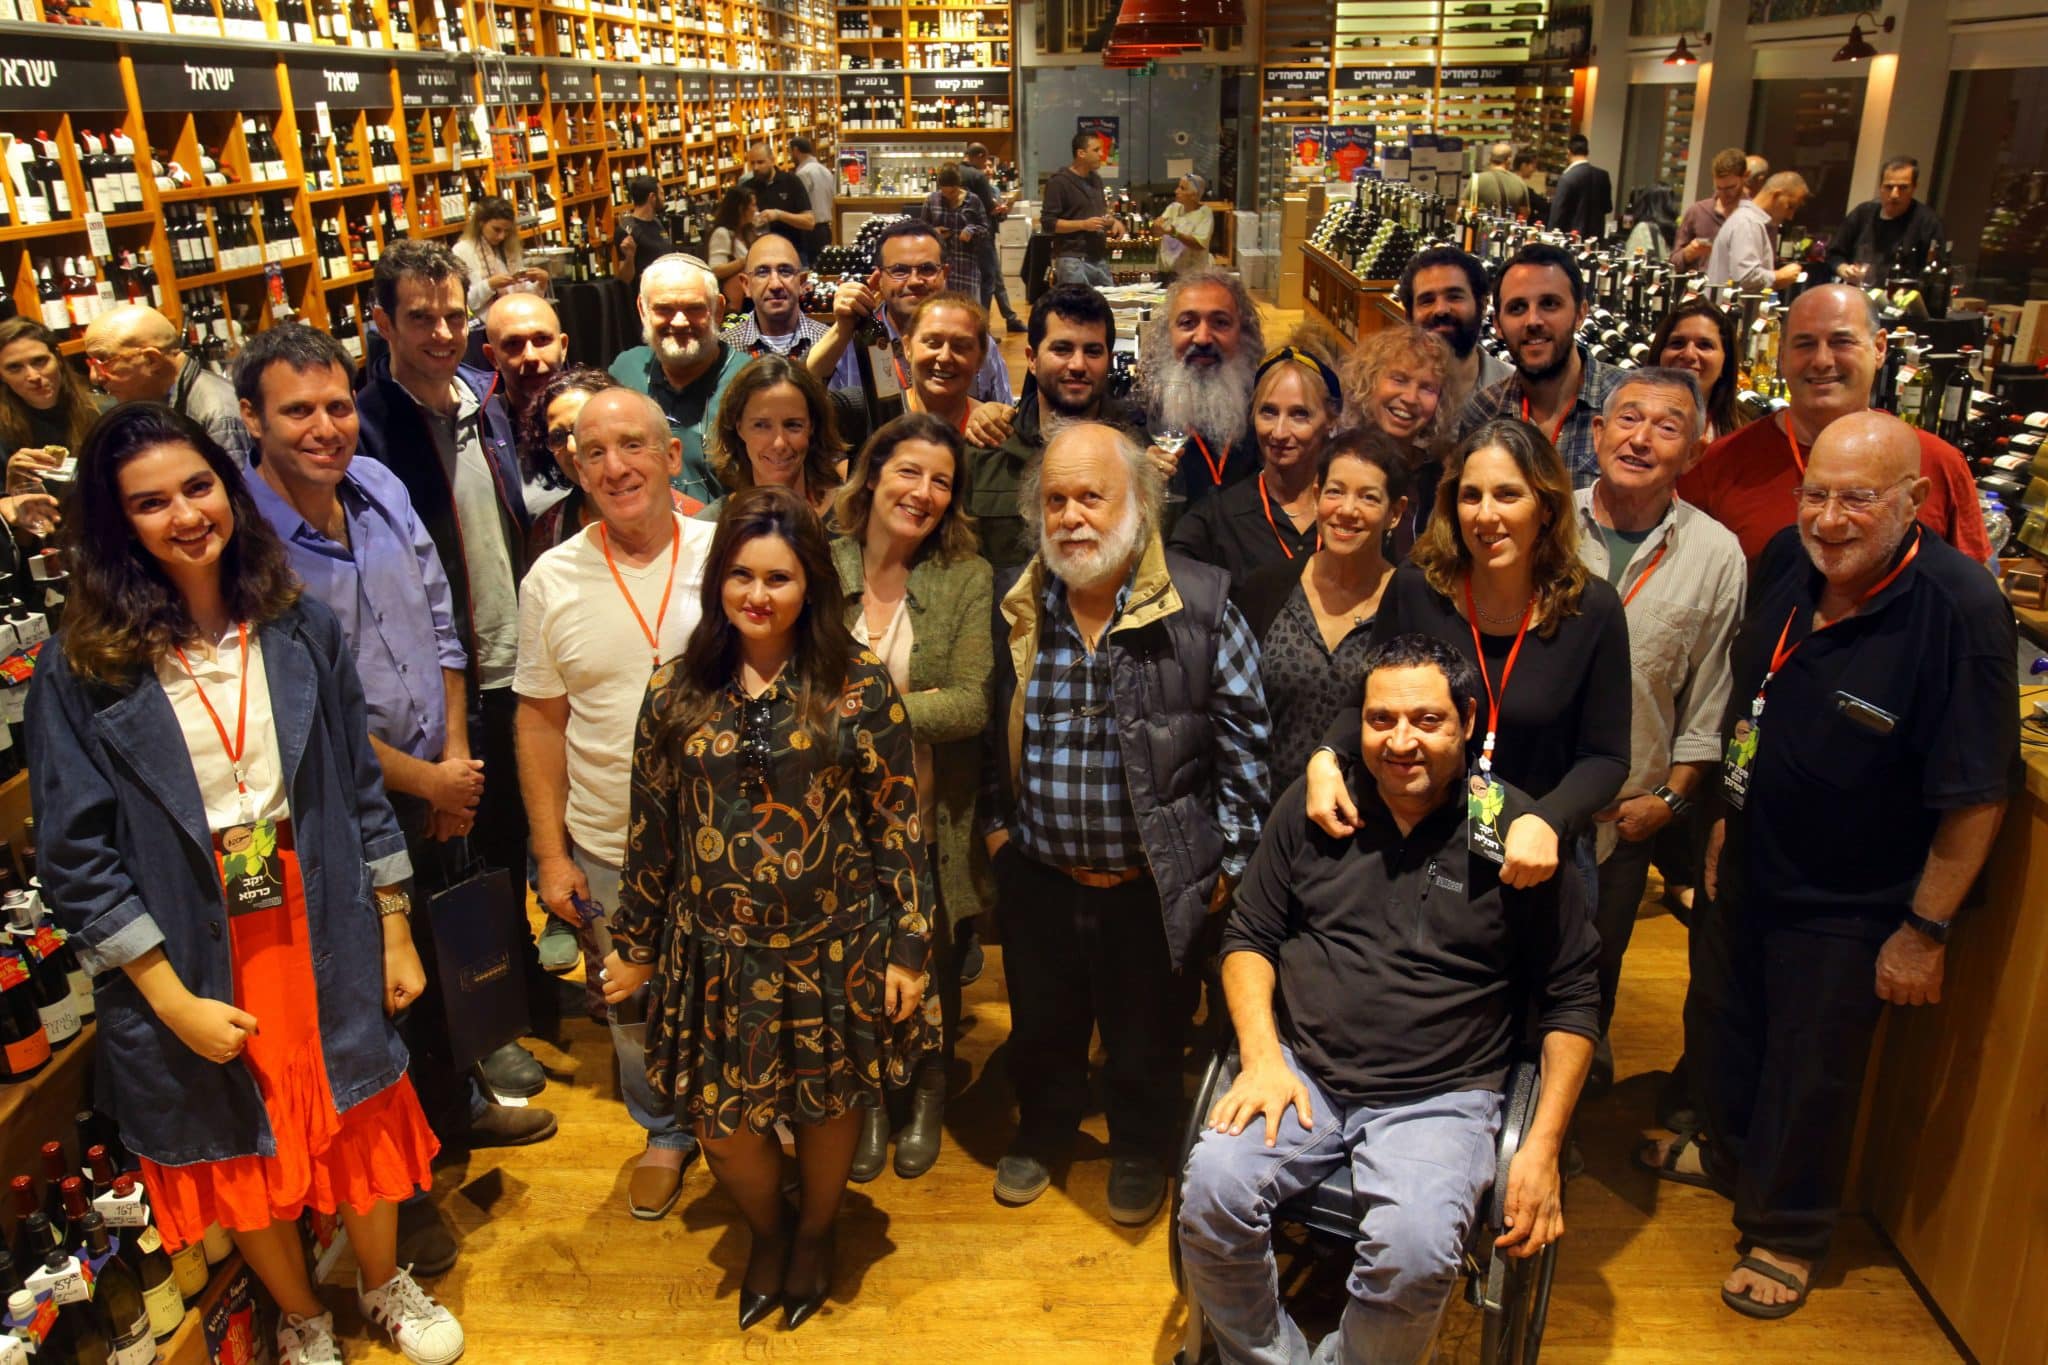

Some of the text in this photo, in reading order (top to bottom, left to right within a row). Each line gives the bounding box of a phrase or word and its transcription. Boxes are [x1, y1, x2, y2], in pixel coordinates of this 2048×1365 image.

[0, 58, 57, 88] ישרא
[184, 62, 235, 91] ישראל
[323, 69, 360, 92] ישראל
[1268, 71, 1325, 80] יינות מיוחדים
[1354, 70, 1416, 81] יינות מיוחדים
[242, 875, 264, 888] יקב
[239, 887, 271, 902] כרמא
